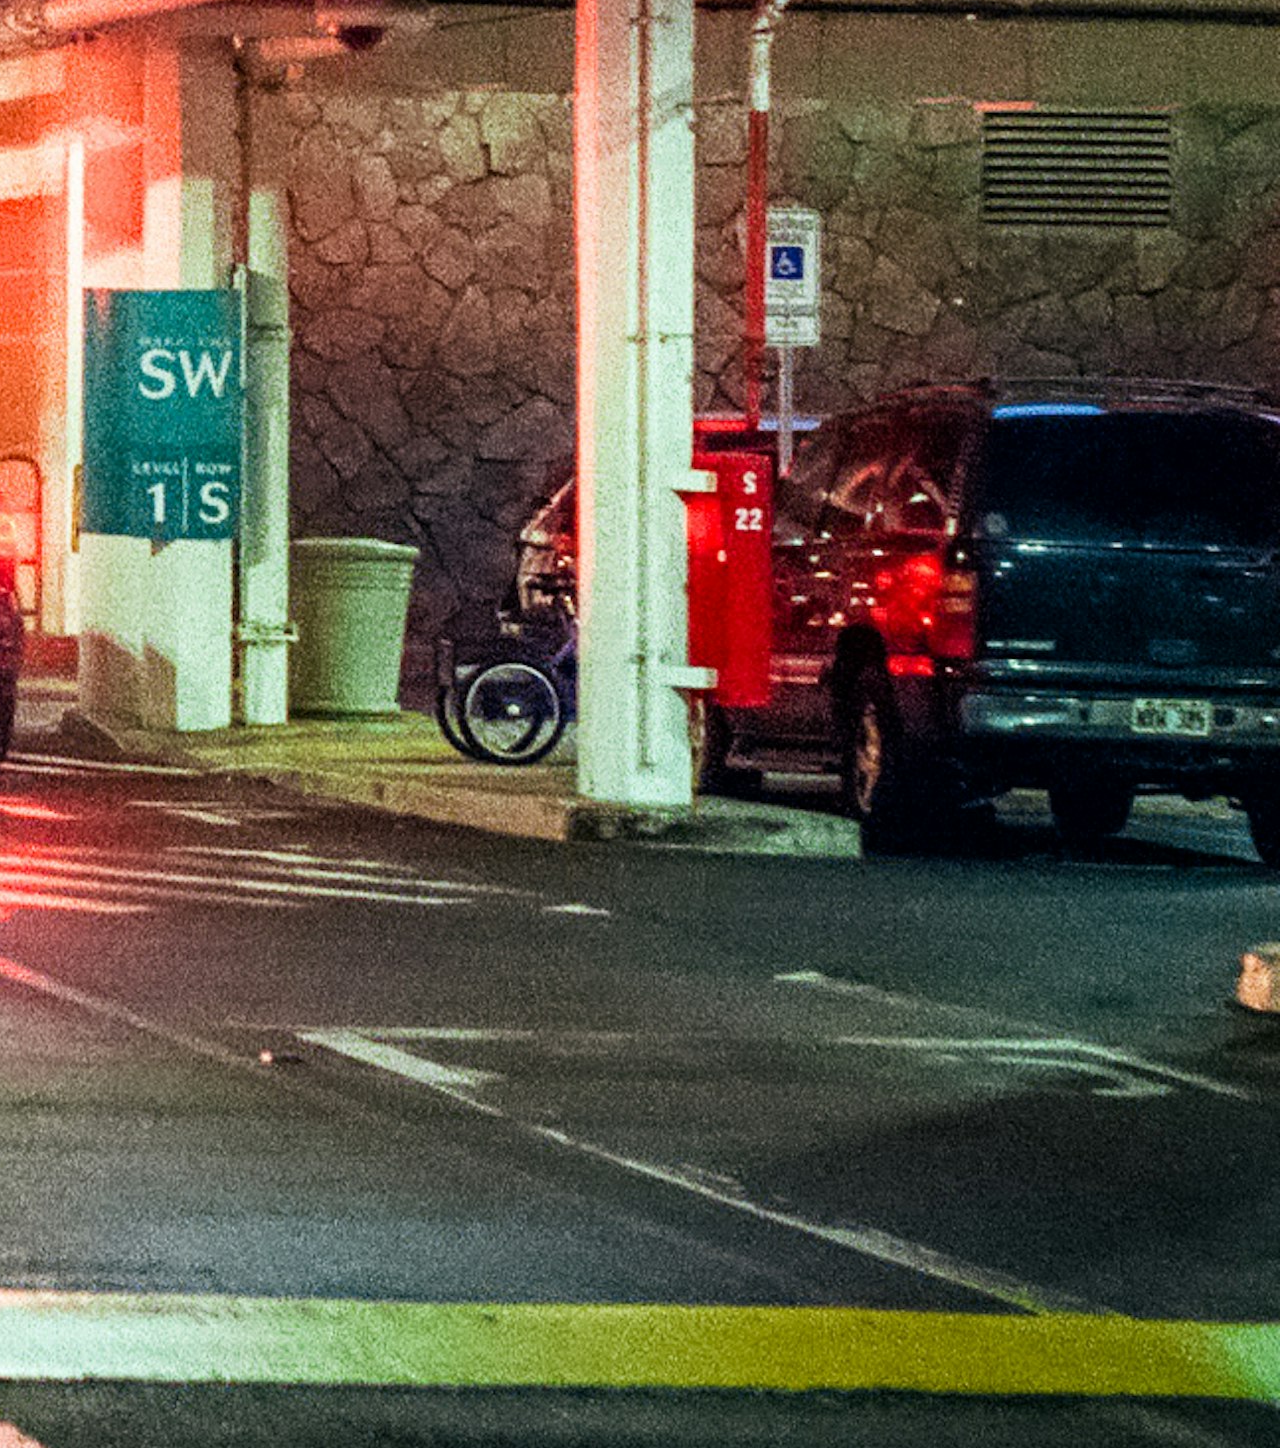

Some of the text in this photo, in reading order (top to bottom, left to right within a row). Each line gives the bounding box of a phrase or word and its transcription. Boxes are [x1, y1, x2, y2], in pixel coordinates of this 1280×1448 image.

[138, 348, 234, 400] SW
[147, 482, 166, 524] 1
[199, 481, 231, 524] S
[743, 470, 758, 495] S
[734, 506, 764, 532] 22
